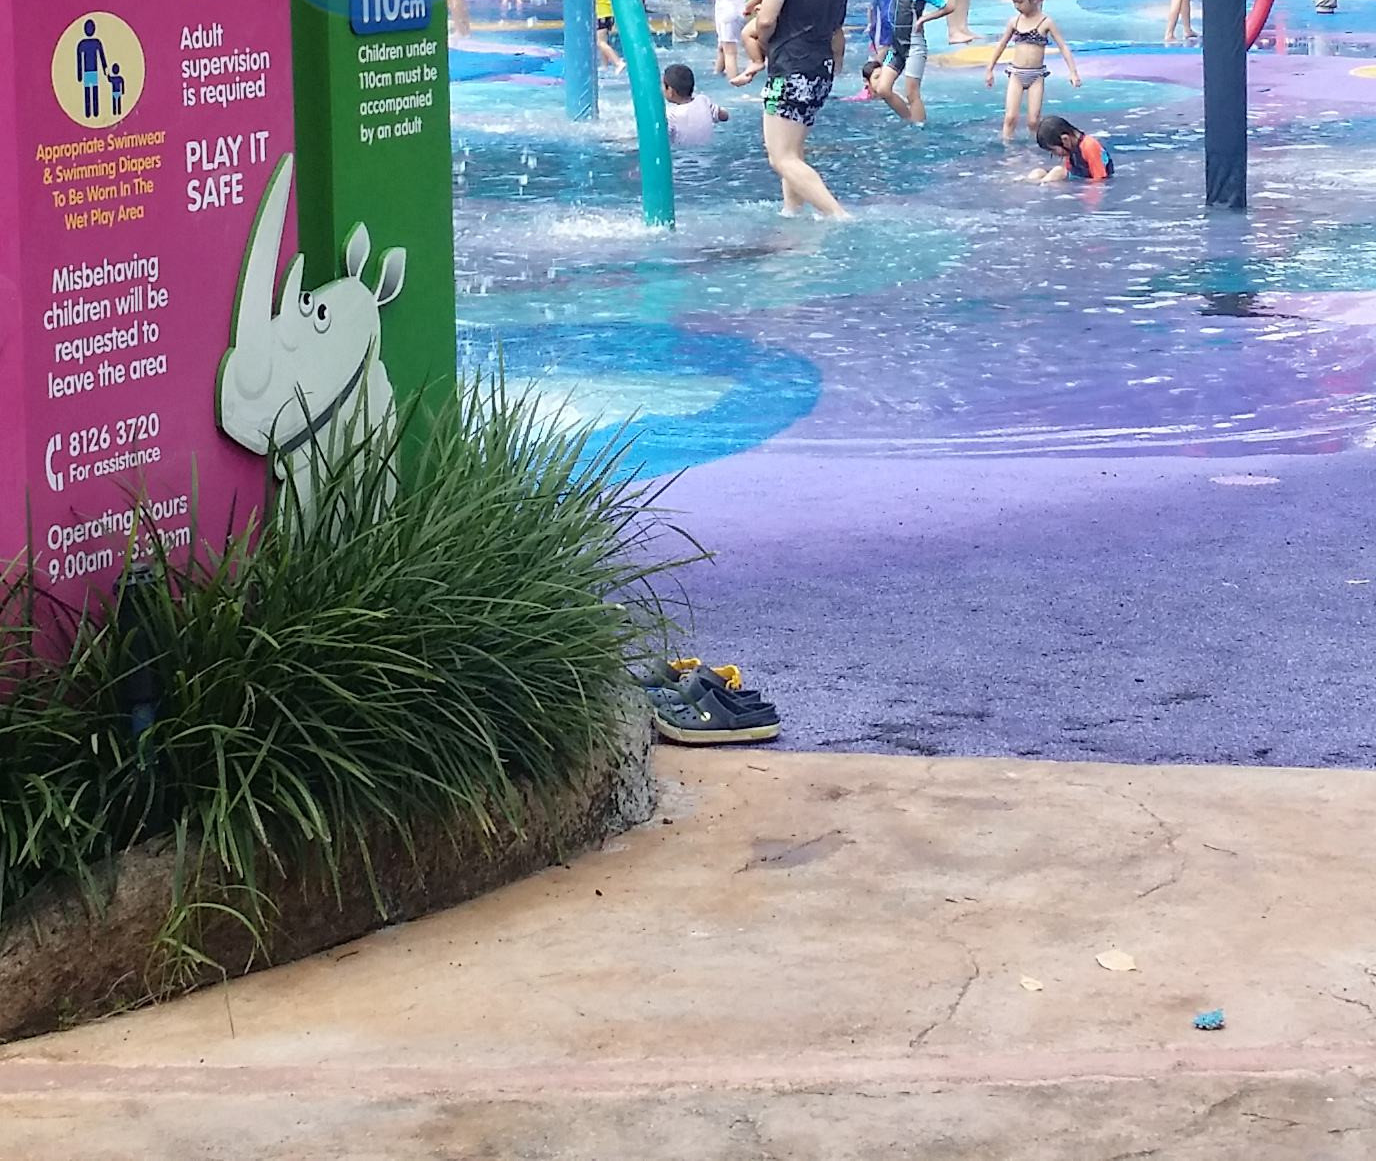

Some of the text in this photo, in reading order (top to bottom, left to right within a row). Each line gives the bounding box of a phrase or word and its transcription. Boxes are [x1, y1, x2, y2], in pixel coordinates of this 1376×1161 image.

[180, 22, 224, 50] Adult
[358, 38, 437, 64] Children under
[181, 47, 270, 82] supervision
[358, 63, 437, 90] 110cm must be
[182, 74, 266, 108] is required
[360, 89, 433, 116] accompanied
[35, 129, 166, 164] Appropriate Swimwear
[360, 115, 423, 146] by an adult
[42, 153, 162, 185] & Swimming Diapers
[185, 130, 270, 174] PLAY IT
[52, 176, 154, 208] To Be Worn In The
[186, 172, 245, 212] SAFE
[64, 204, 144, 231] Wet Play Area
[52, 253, 159, 294] Misbehaving
[43, 283, 169, 330] children will be
[55, 320, 160, 365] requested to
[48, 354, 167, 399] leave the area
[69, 412, 160, 457] 8126 3720
[69, 446, 161, 483] For assistance
[47, 509, 134, 553] Operating
[48, 548, 113, 585] 9.00am
